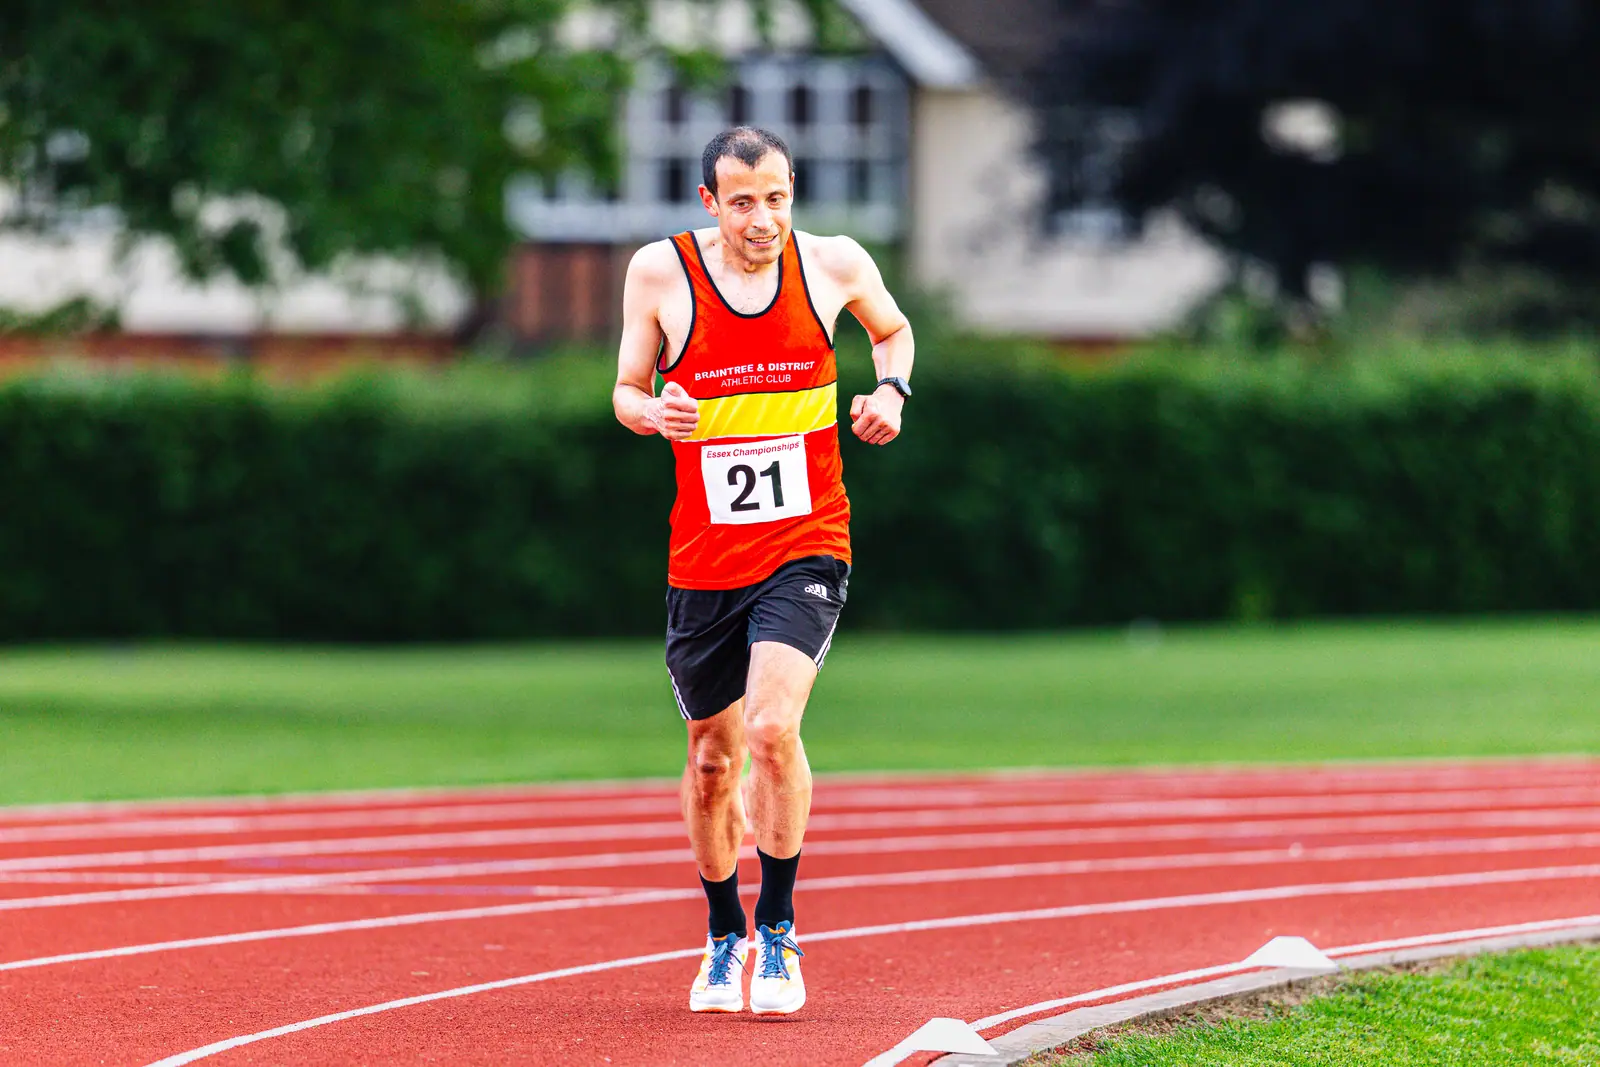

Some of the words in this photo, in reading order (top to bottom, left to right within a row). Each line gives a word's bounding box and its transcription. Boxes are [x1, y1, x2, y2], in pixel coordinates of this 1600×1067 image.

[694, 364, 754, 381] BRAINTREE
[756, 363, 765, 372] &
[768, 361, 815, 372] DISTRICT
[720, 375, 764, 388] ATHLETIC
[766, 374, 792, 383] CLUB
[706, 450, 732, 459] Essex
[733, 441, 800, 456] Championships
[727, 460, 784, 512] 21
